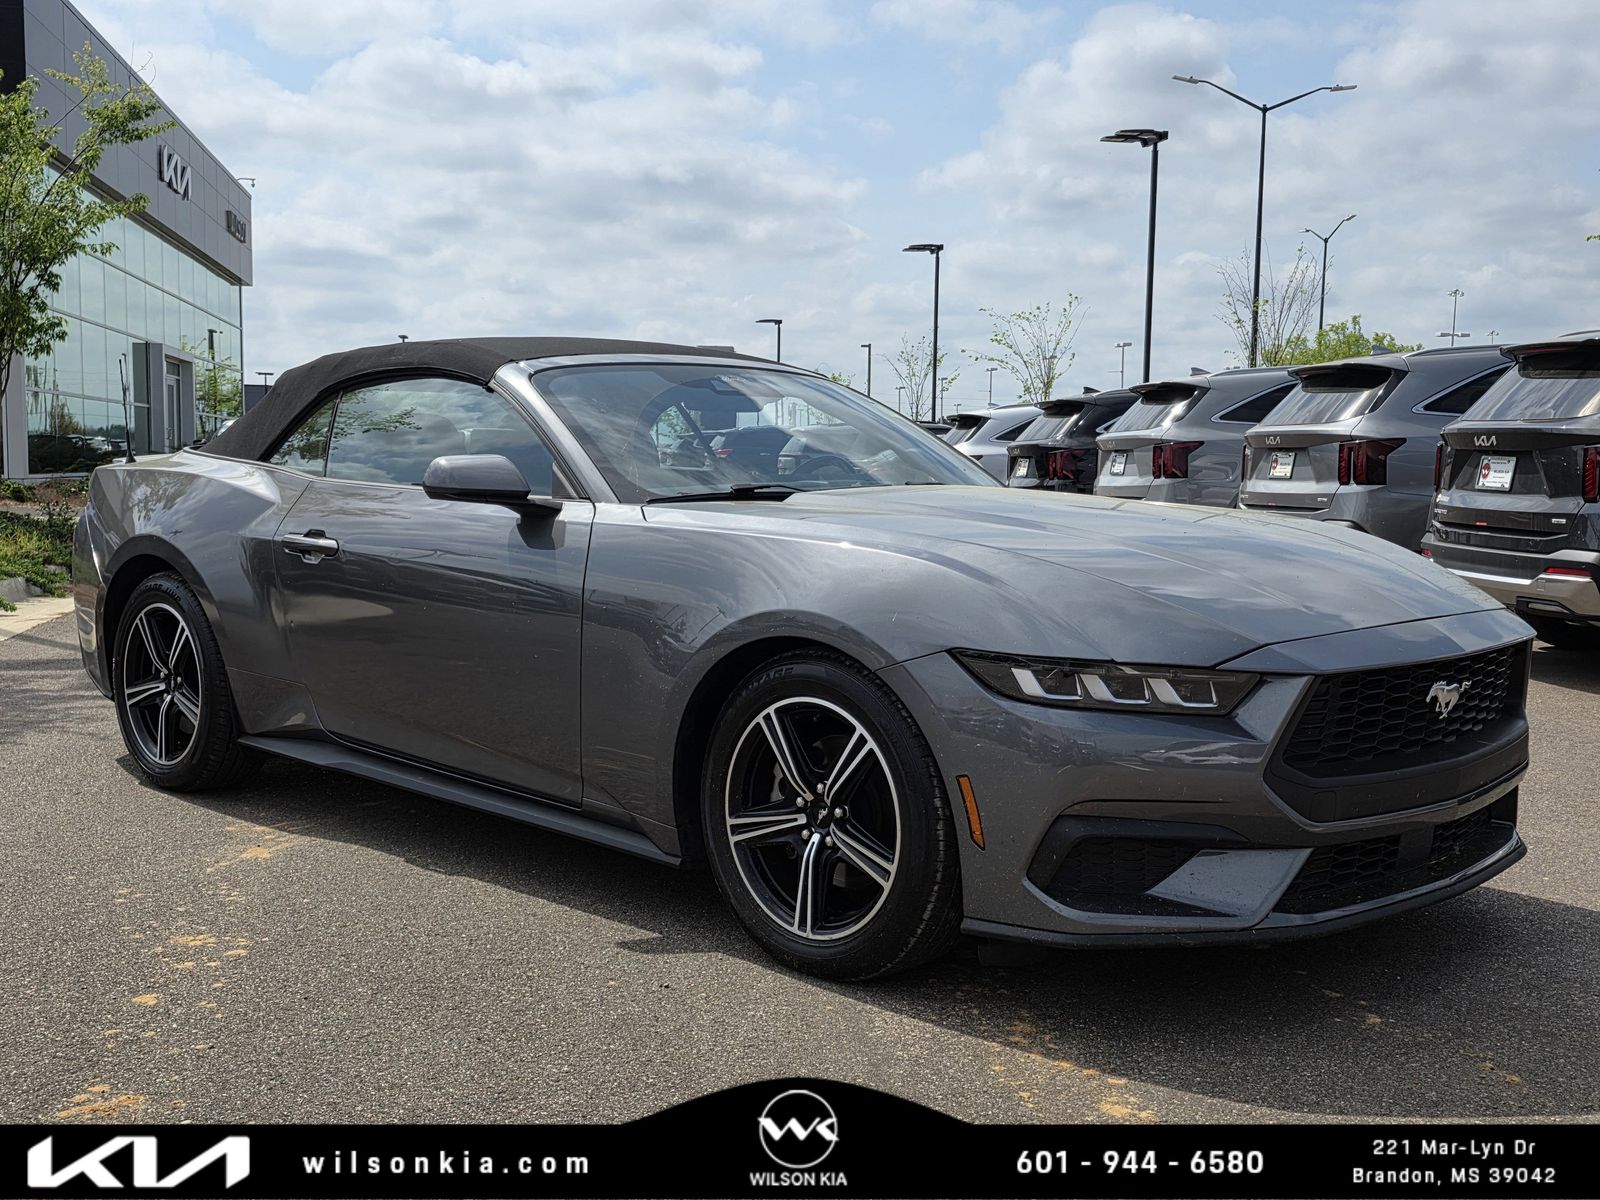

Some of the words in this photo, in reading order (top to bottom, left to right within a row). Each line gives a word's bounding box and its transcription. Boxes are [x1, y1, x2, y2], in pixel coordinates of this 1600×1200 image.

[160, 144, 192, 201] KIA
[1265, 436, 1281, 445] KIA
[1474, 435, 1497, 447] KIA
